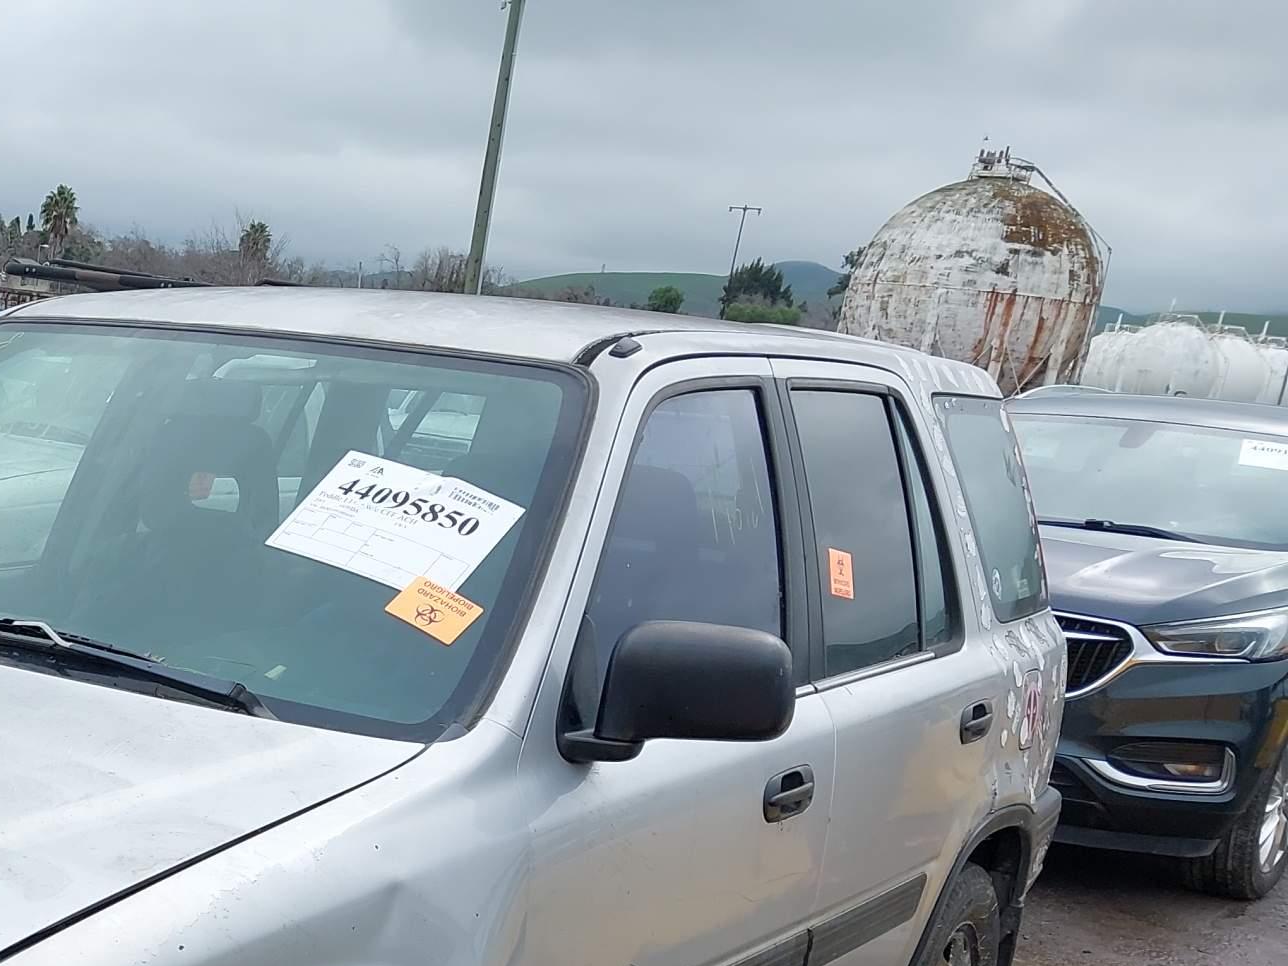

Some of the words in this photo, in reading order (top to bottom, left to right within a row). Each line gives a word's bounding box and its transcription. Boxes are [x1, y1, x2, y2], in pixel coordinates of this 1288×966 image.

[338, 478, 480, 536] 44095850
[417, 588, 467, 617] BIOHAZARD
[423, 580, 474, 611] BIOPELIGRO
